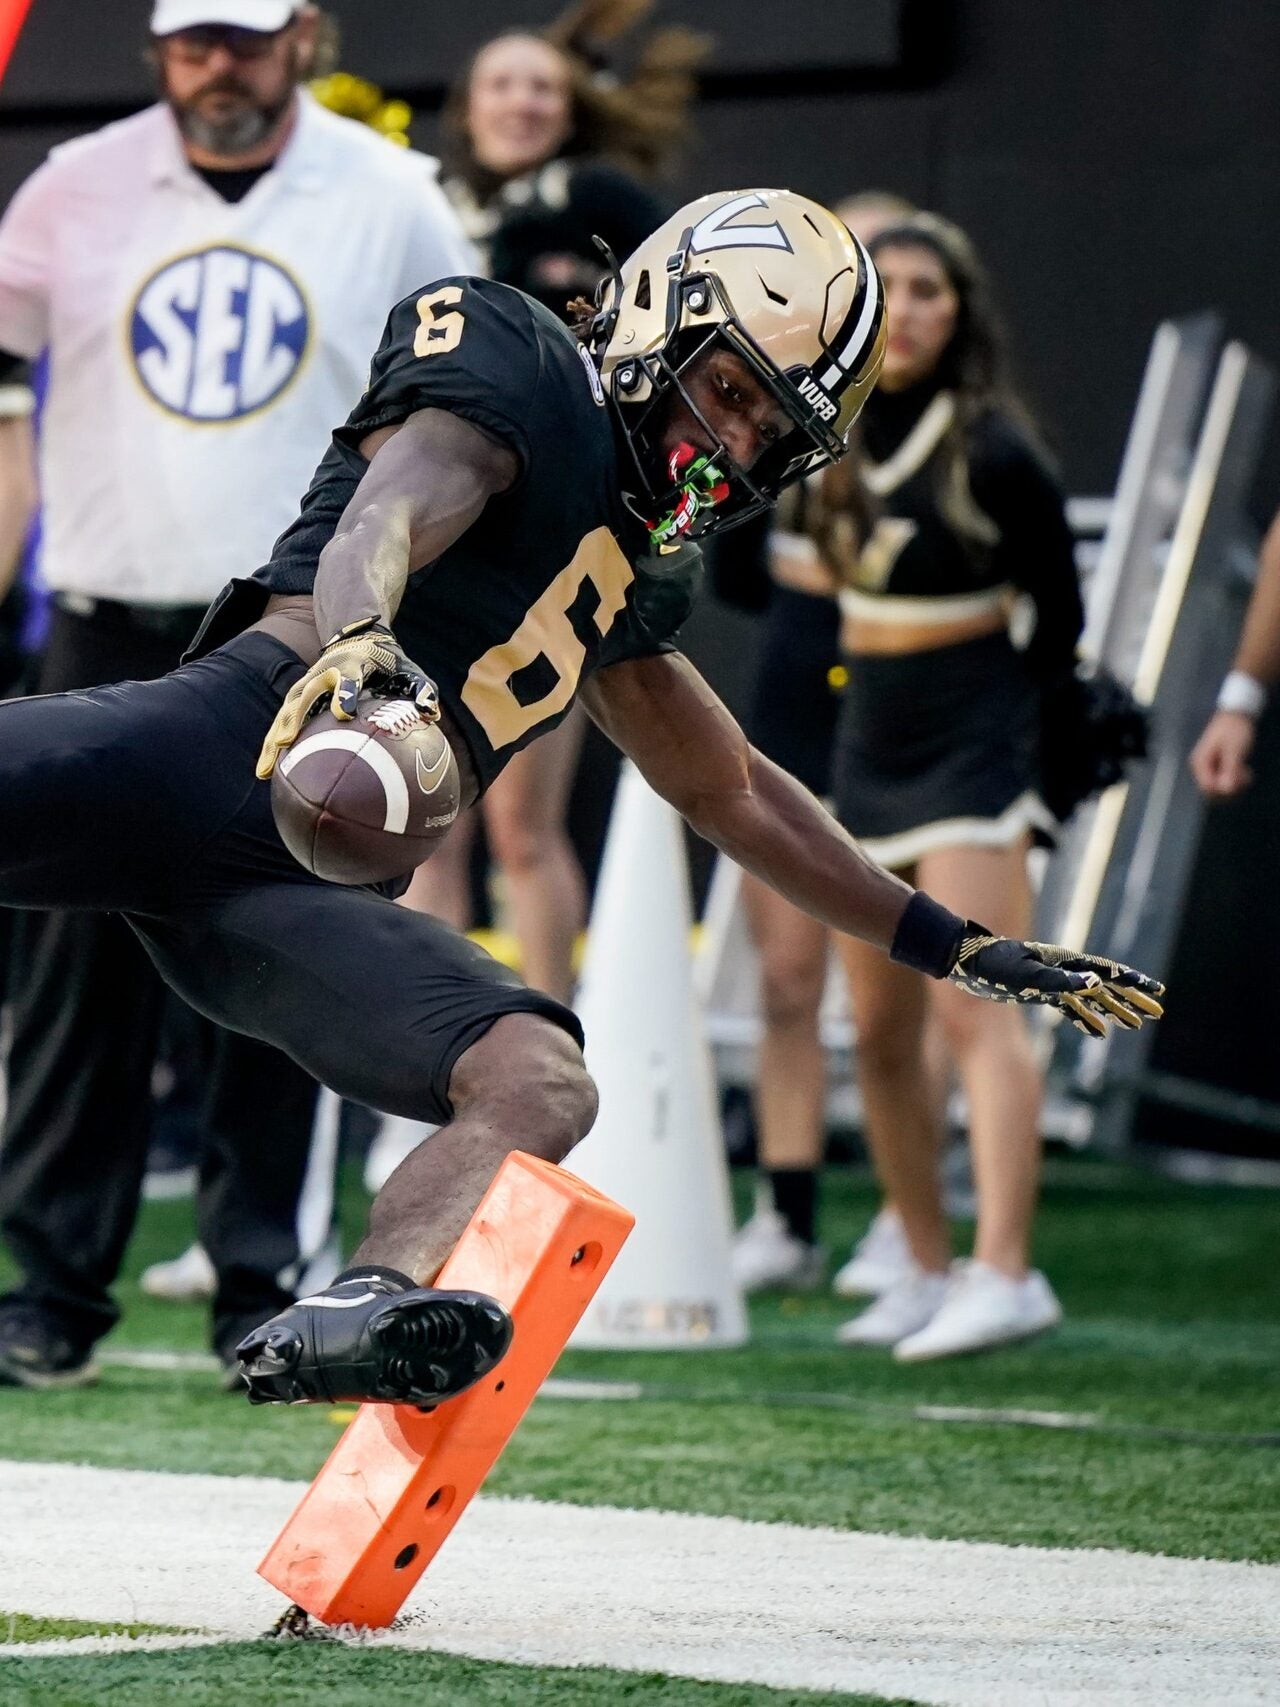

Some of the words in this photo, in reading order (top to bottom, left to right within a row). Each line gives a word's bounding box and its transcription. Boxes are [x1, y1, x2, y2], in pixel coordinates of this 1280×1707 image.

[690, 191, 795, 256] V
[132, 248, 308, 419] SEC
[413, 286, 465, 358] 6
[798, 375, 837, 422] VUFB
[460, 524, 635, 751] 6
